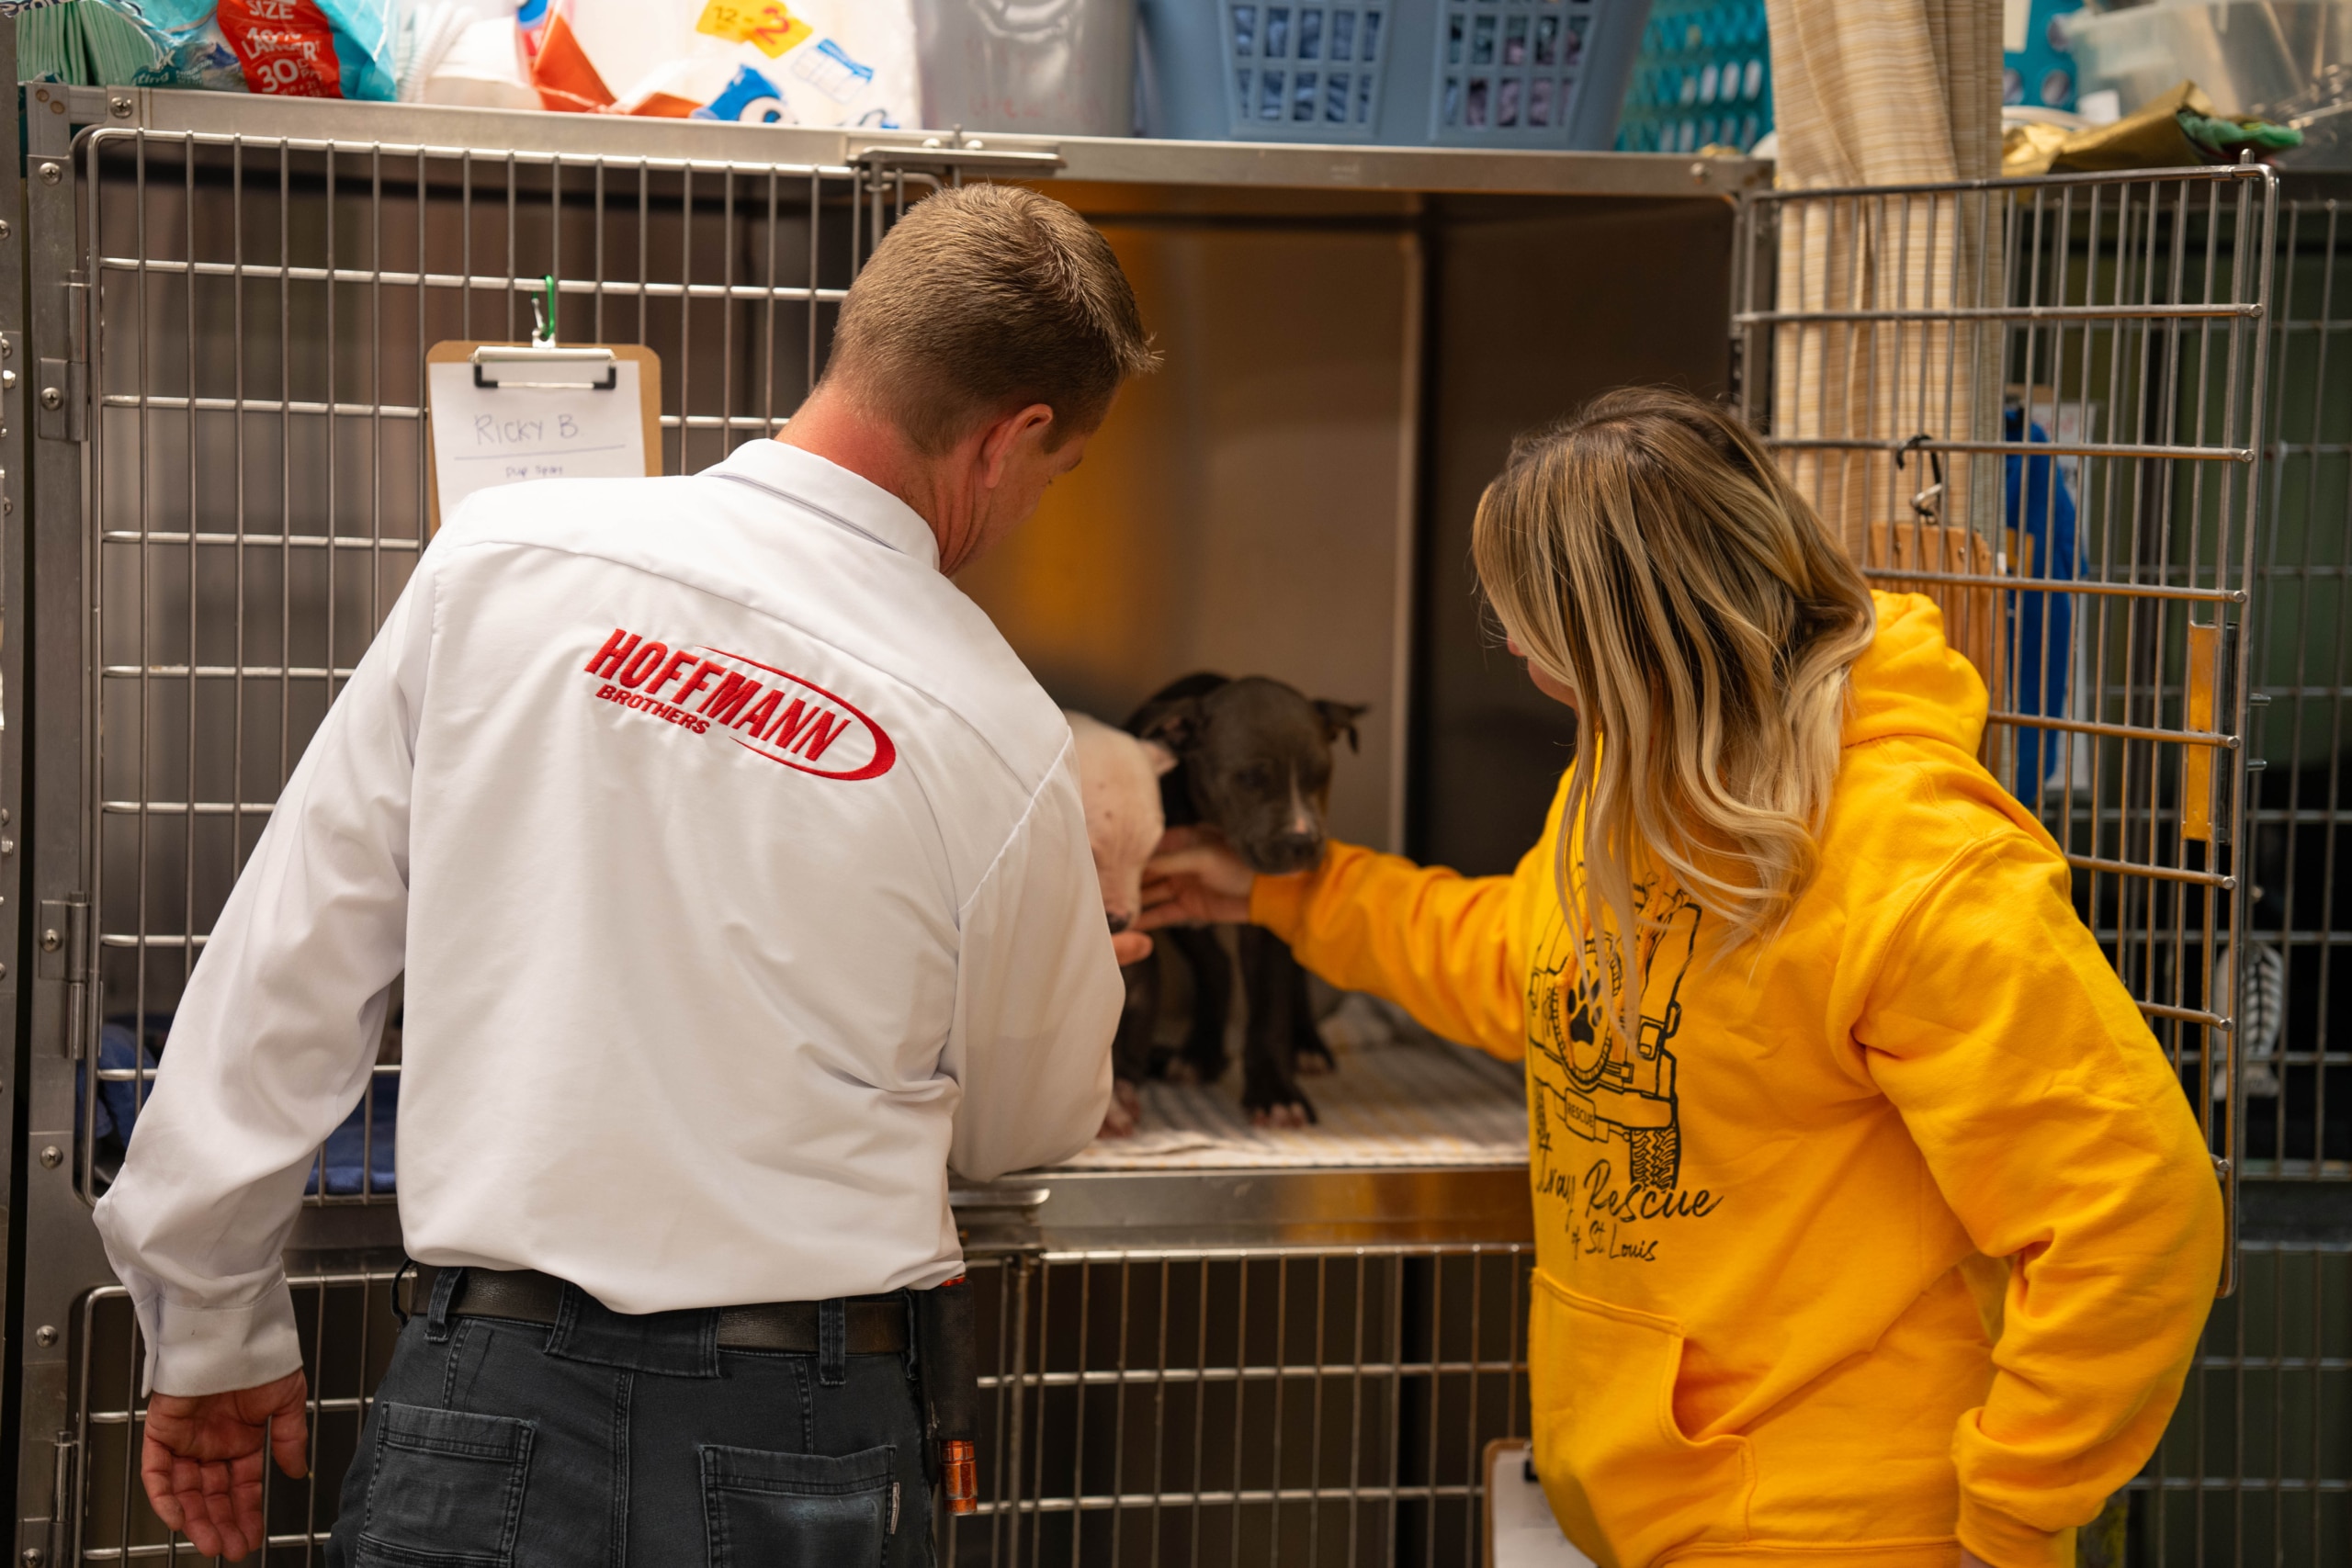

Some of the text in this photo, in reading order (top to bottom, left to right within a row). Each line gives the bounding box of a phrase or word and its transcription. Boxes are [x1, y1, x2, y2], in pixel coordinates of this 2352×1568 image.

[246, 0, 295, 19] SIZE
[257, 59, 299, 93] 30
[558, 414, 579, 440] B
[583, 628, 852, 761] HOFFMANN
[595, 683, 710, 734] BROTHERS
[1567, 1102, 1595, 1129] RESCUE
[1583, 1158, 1724, 1223] Rescue
[1609, 1223, 1659, 1262] Louis
